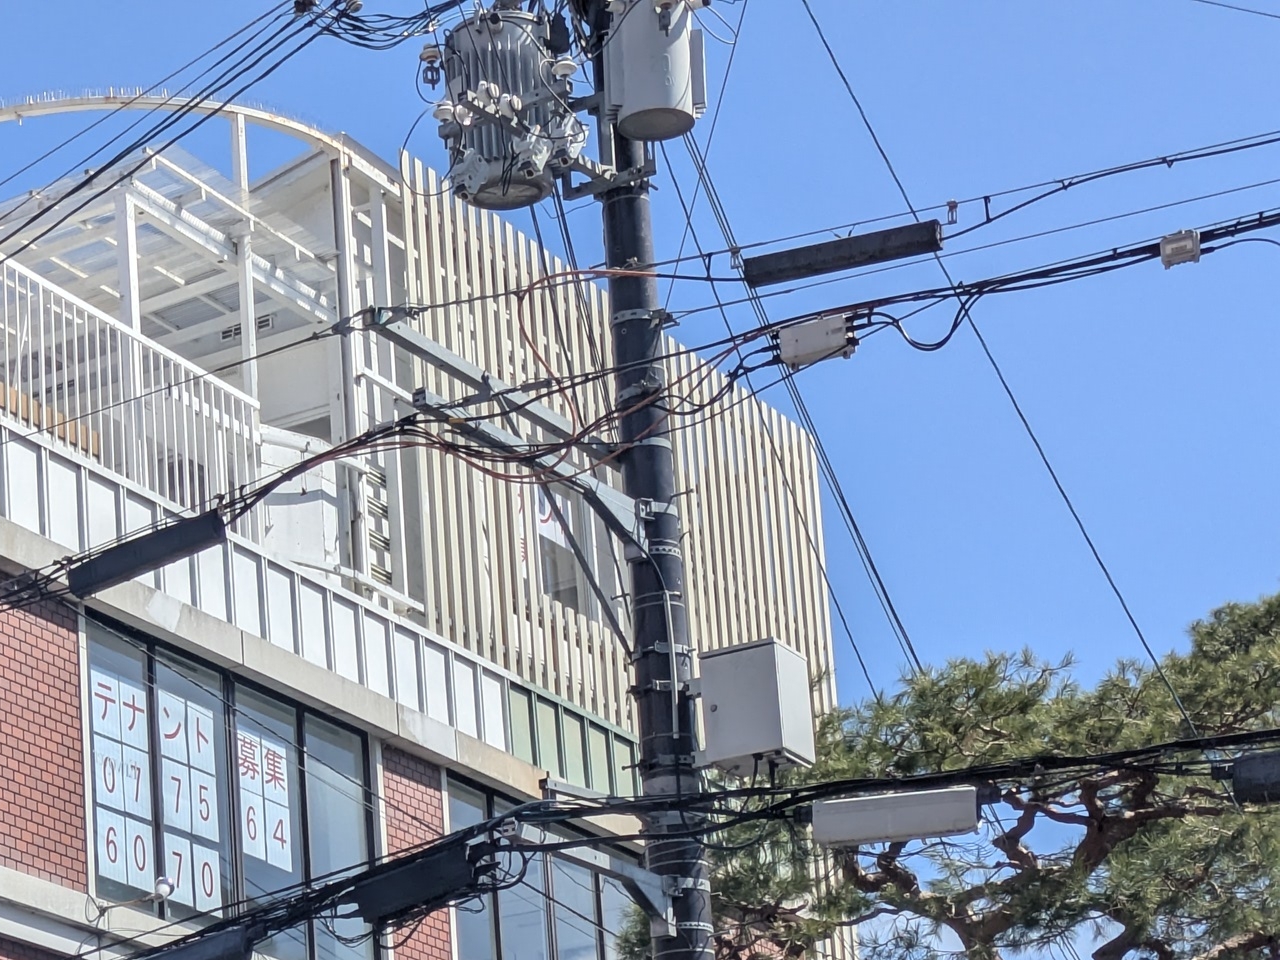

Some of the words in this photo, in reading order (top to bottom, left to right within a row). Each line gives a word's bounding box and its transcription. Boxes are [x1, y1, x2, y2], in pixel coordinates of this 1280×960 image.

[94, 682, 286, 792] テナント募集
[105, 826, 214, 898] 6070
